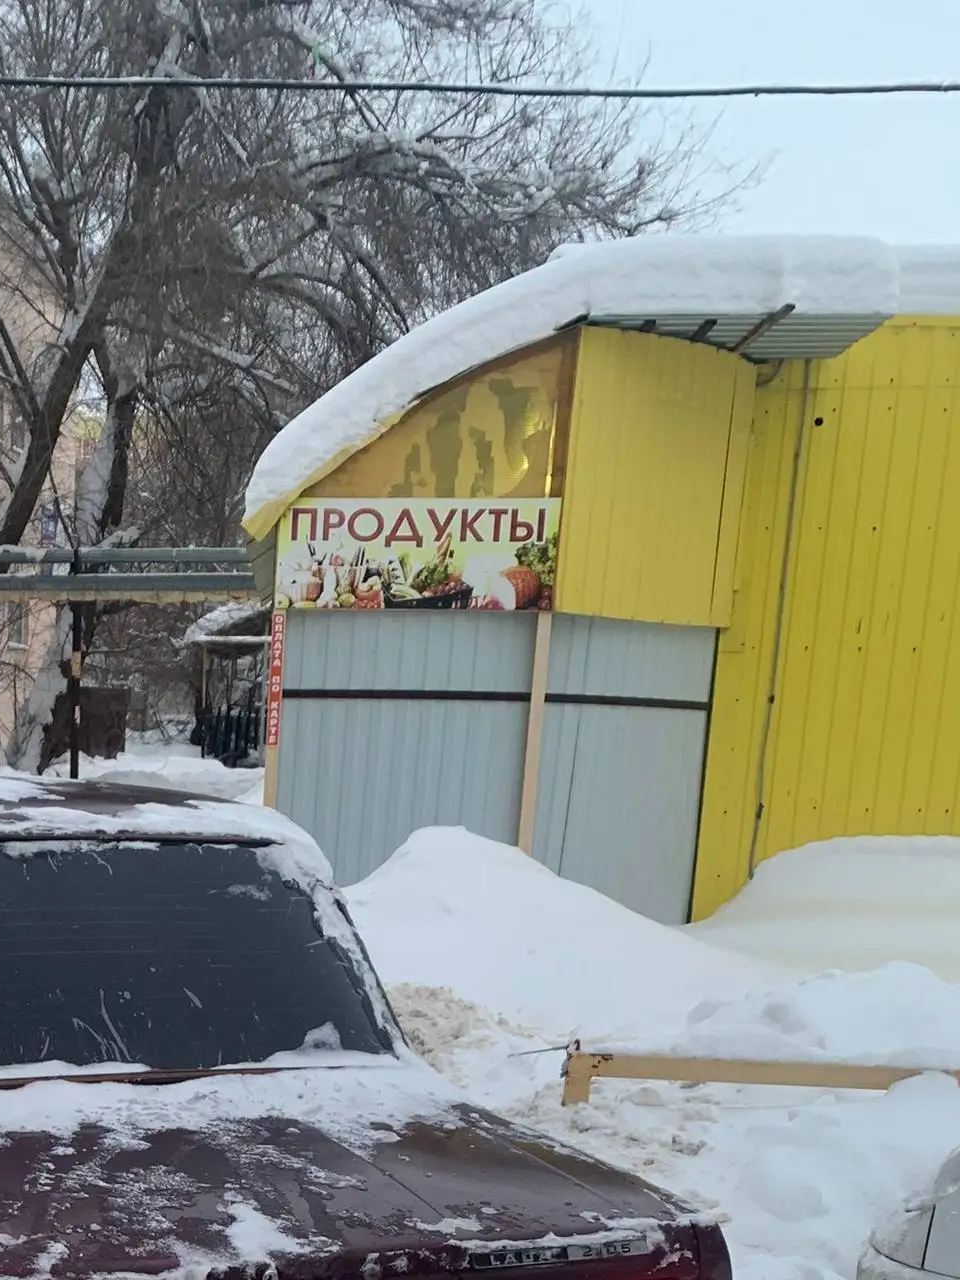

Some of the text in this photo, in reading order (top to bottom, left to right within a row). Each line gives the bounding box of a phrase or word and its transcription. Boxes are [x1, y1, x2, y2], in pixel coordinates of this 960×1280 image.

[290, 507, 547, 548] ПРОДУКТЫ
[268, 615, 284, 743] ОПЛАТА ПО КАРТЕ
